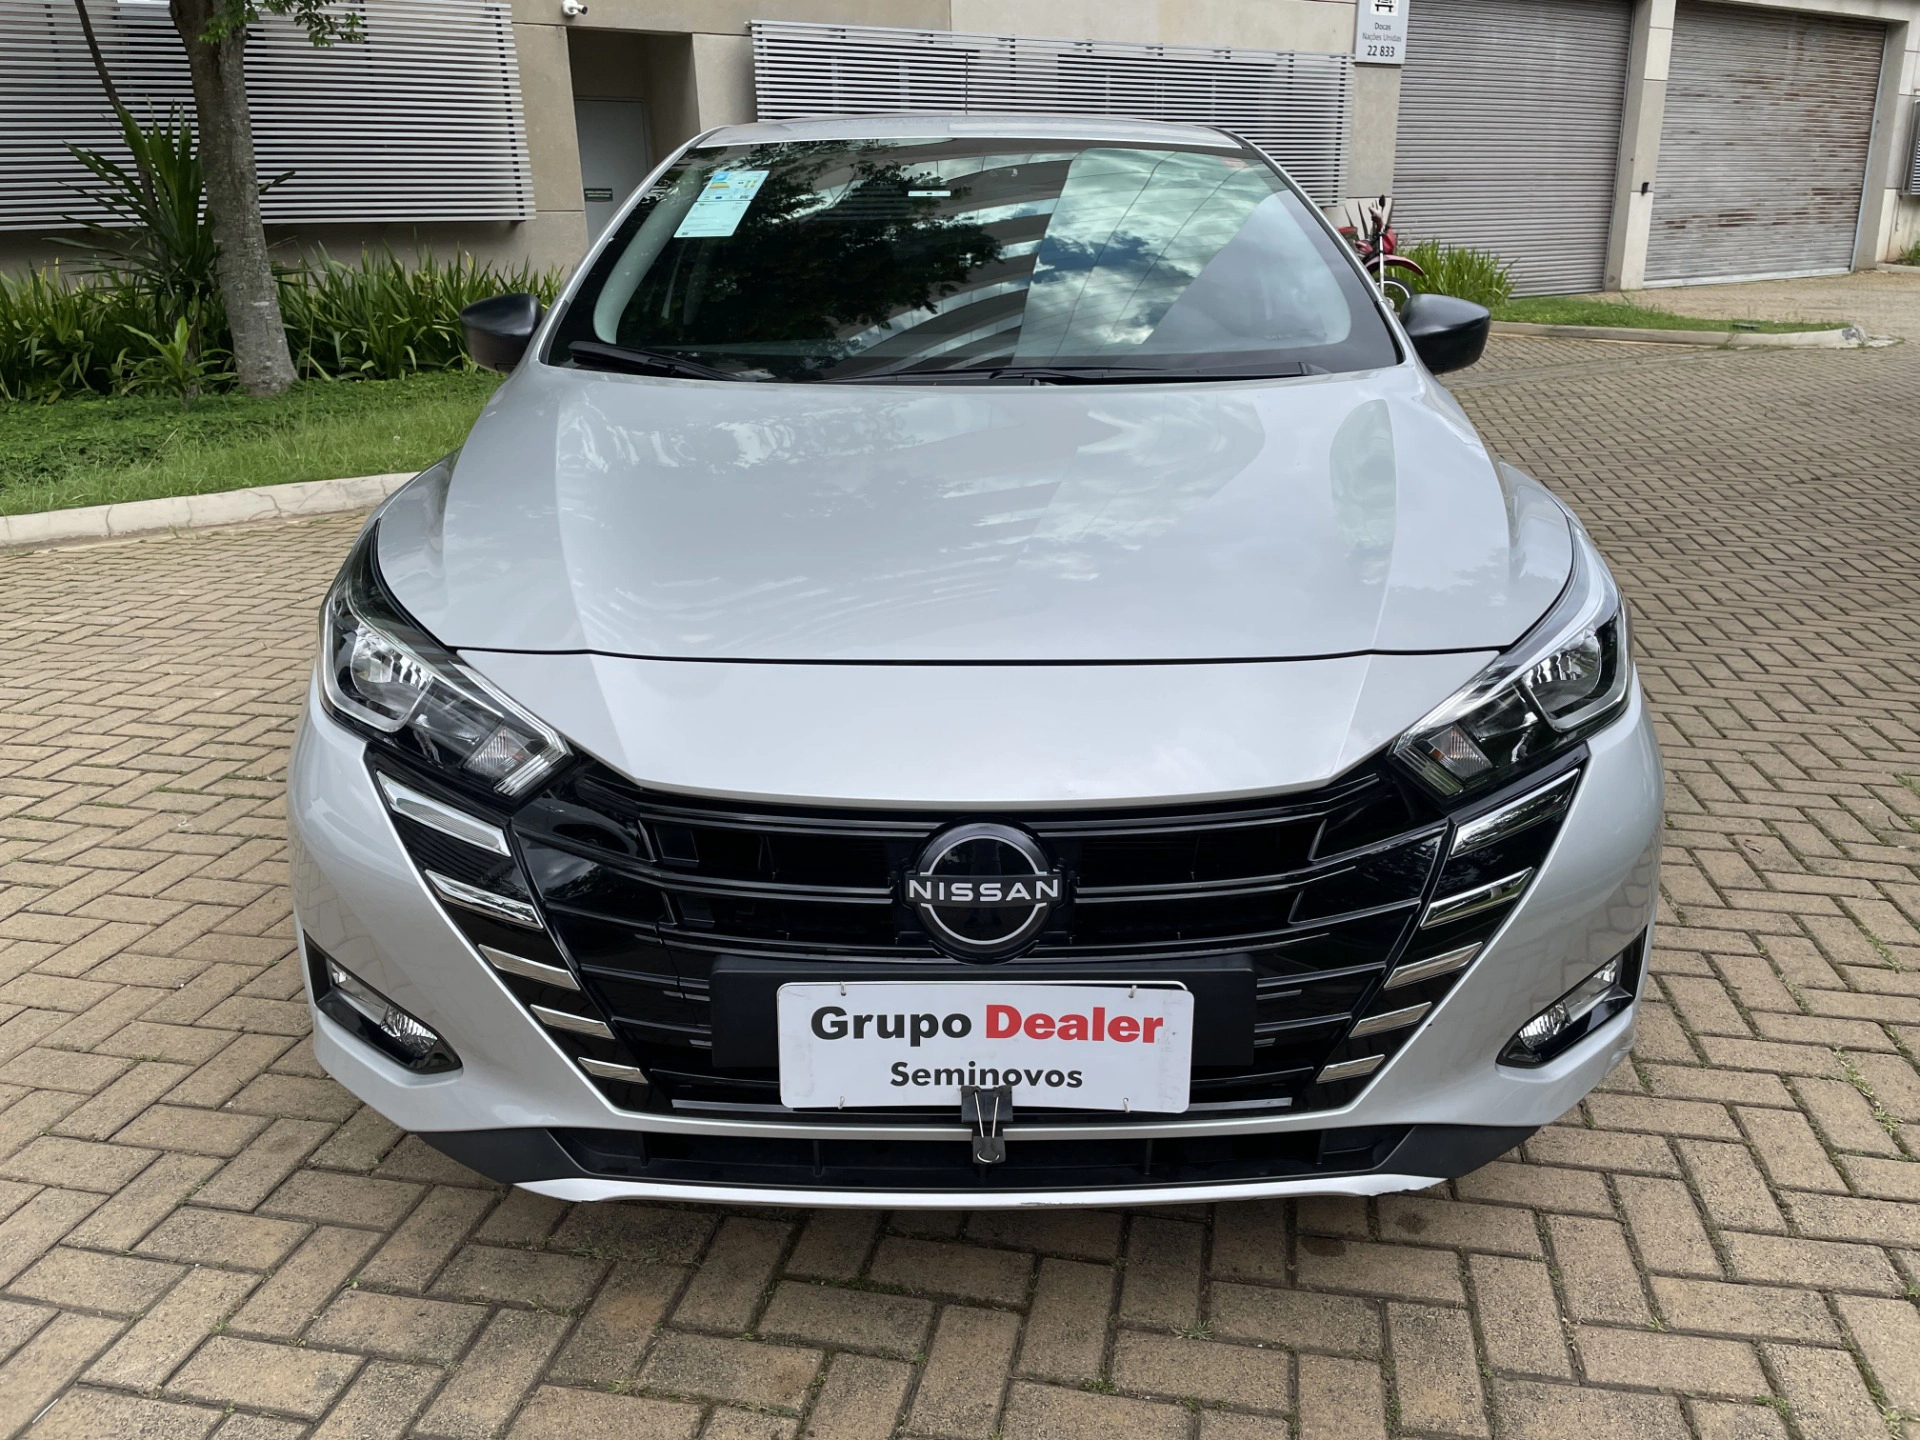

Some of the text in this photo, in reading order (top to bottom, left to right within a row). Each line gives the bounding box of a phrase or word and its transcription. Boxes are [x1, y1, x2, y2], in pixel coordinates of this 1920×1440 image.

[1374, 22, 1391, 30] Docas
[1383, 34, 1401, 42] Unidas
[1367, 45, 1395, 57] 22 833
[909, 879, 1058, 901] NISSAN
[811, 1004, 1164, 1047] Grupo Dealer
[890, 1061, 1083, 1088] Seminovos
